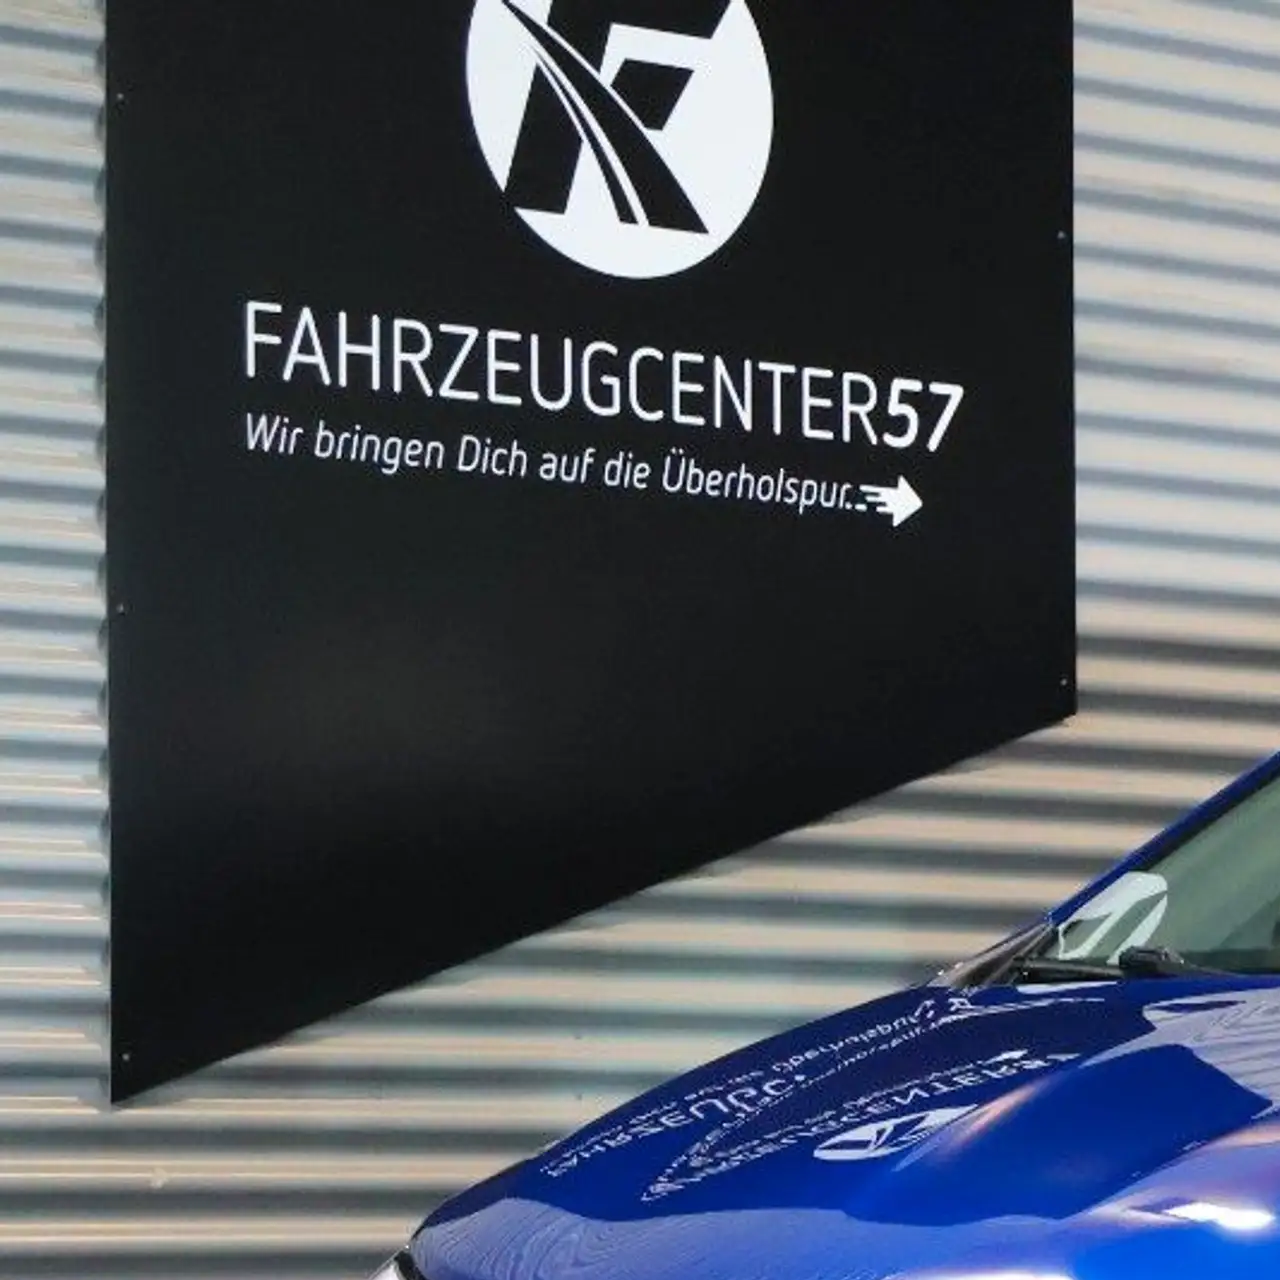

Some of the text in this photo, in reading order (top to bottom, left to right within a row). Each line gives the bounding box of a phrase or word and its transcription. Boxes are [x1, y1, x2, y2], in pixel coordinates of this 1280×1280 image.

[245, 299, 965, 452] FAHRZEUGCENTER57
[246, 411, 303, 455] Wir
[313, 419, 445, 476] bringen
[457, 434, 528, 478] Dich
[538, 447, 597, 485] auf
[602, 450, 651, 489] die
